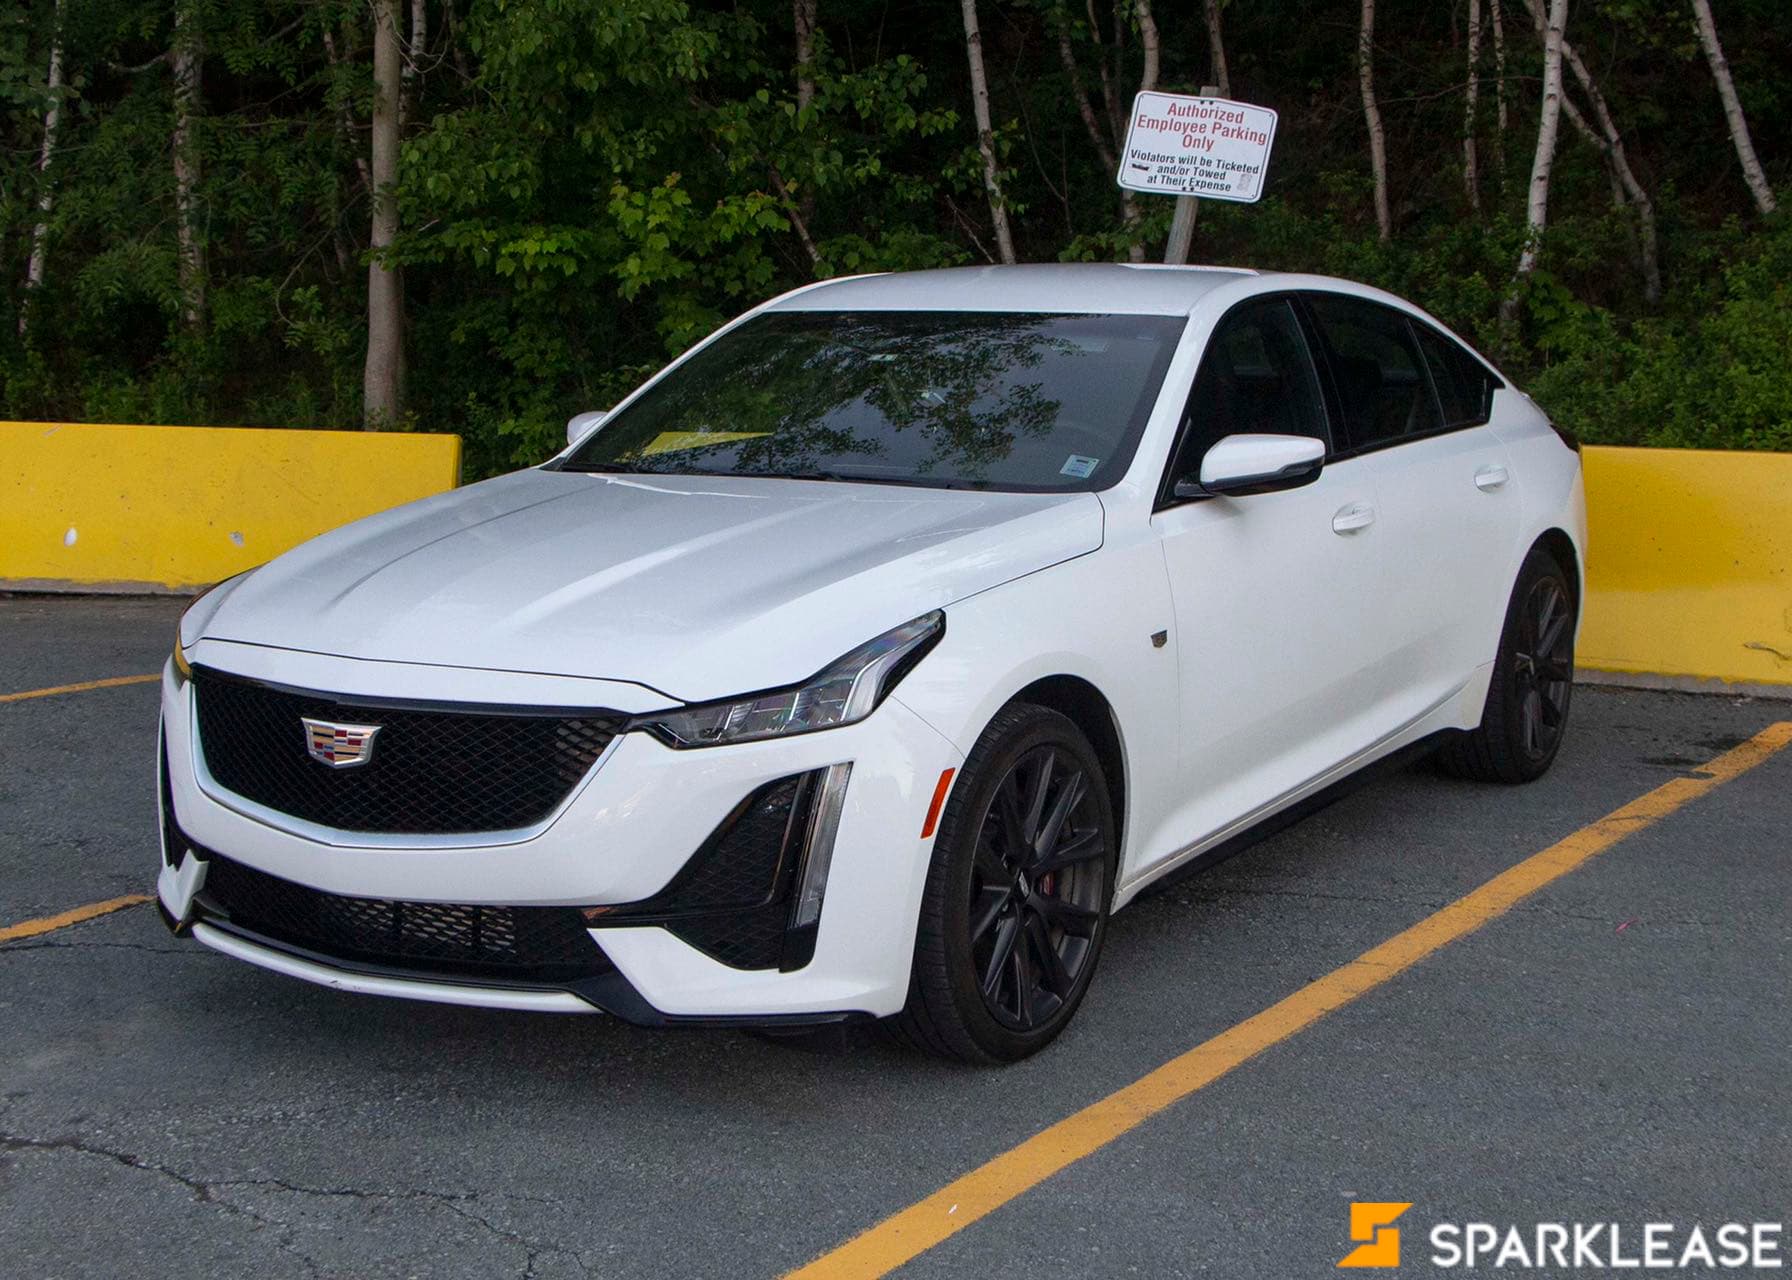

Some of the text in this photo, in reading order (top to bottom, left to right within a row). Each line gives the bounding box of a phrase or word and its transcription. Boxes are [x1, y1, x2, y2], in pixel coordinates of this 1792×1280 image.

[1168, 103, 1244, 124] Authorized
[1137, 115, 1267, 145] Employee Parking
[1182, 135, 1214, 152] Only
[1131, 149, 1259, 174] Violators will be Ticketed
[1157, 164, 1226, 180] and/or Towed
[1147, 175, 1231, 191] at Their Expense
